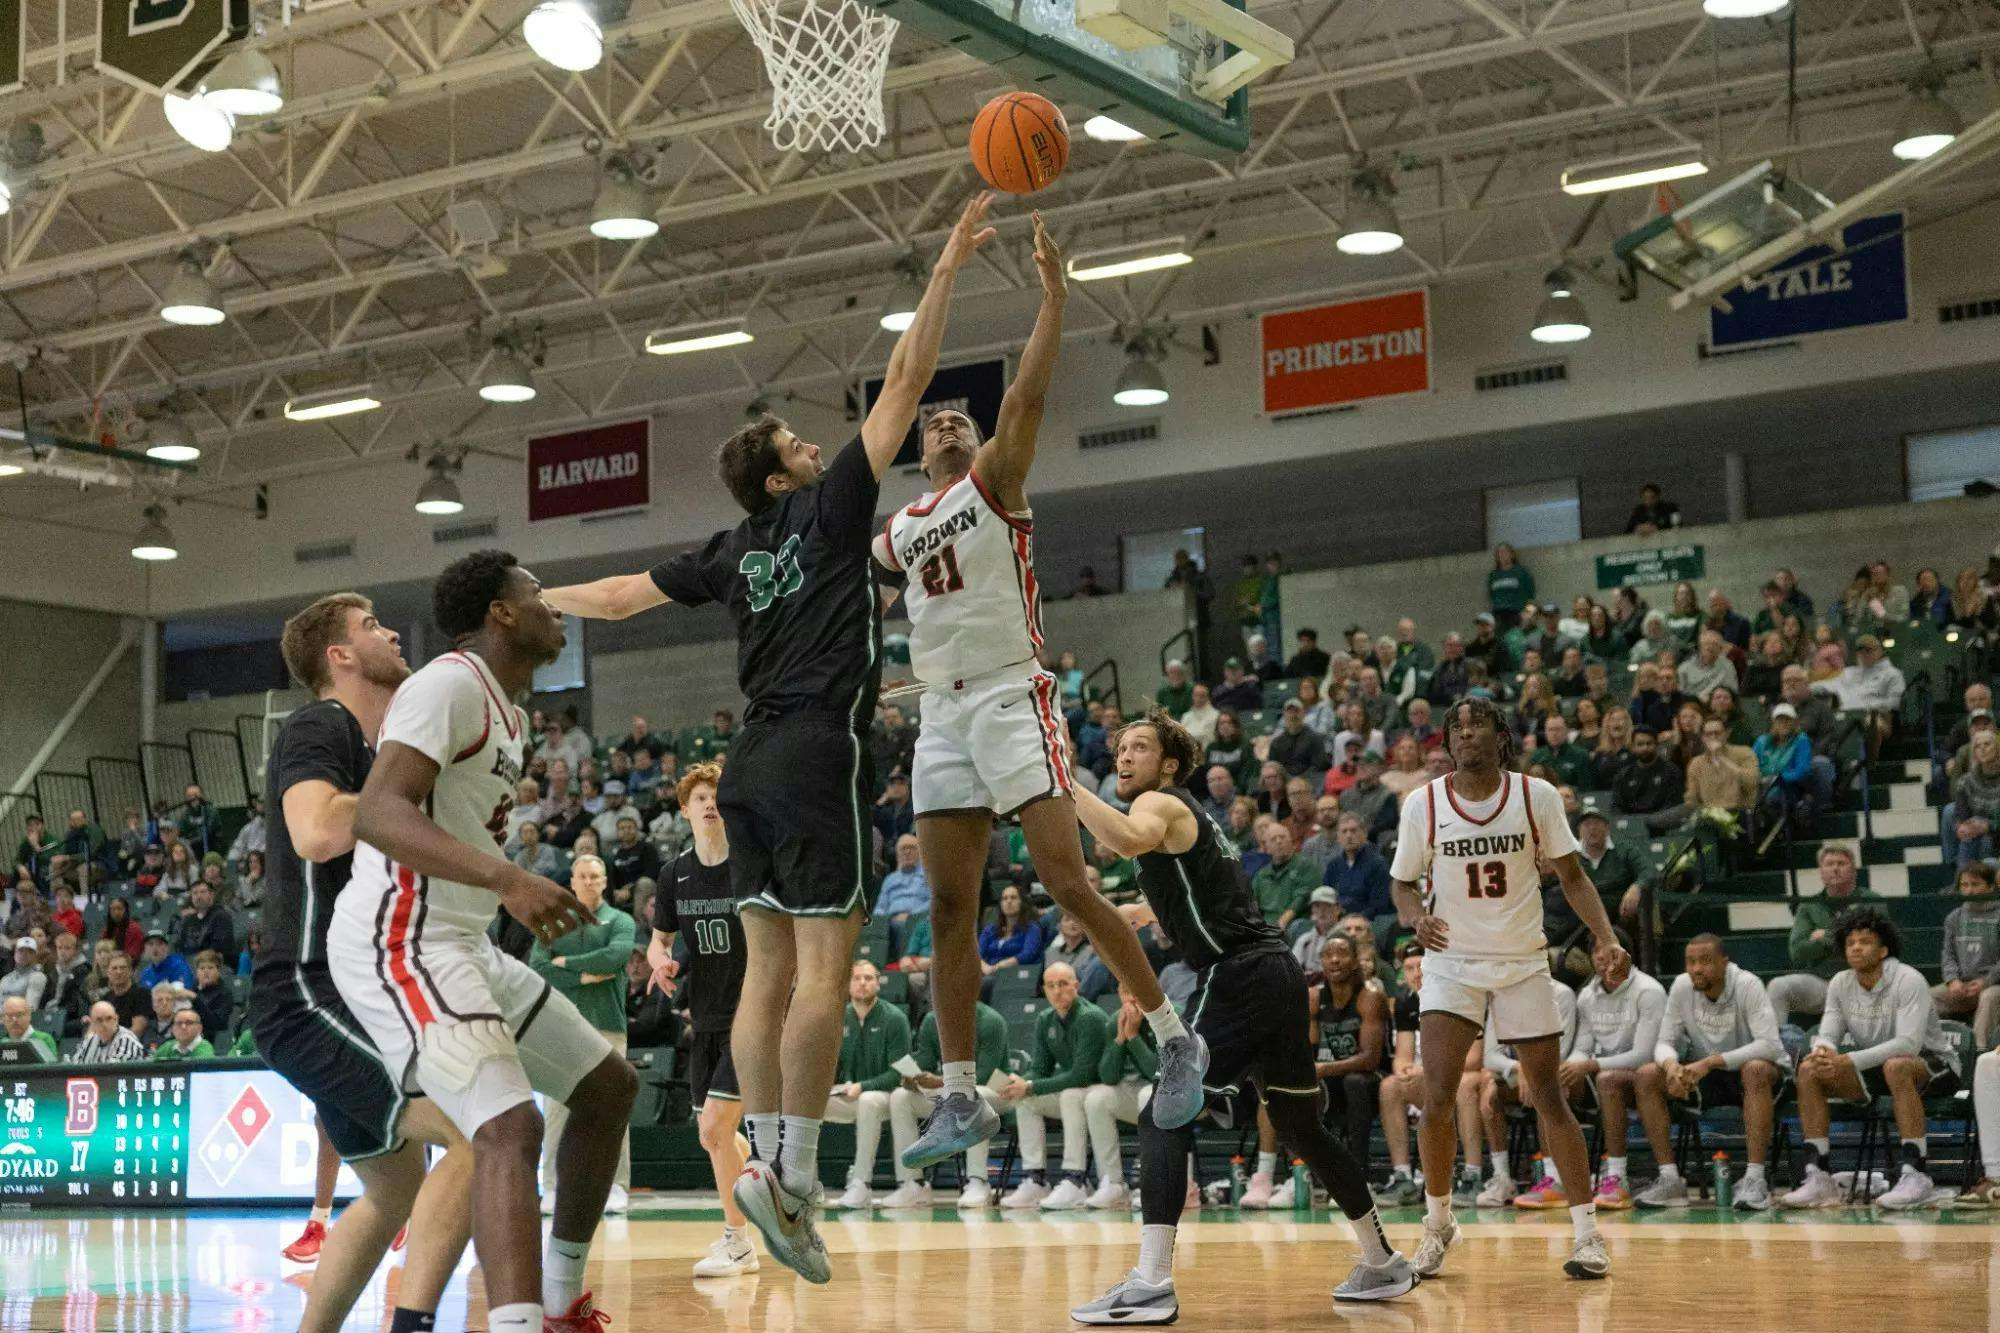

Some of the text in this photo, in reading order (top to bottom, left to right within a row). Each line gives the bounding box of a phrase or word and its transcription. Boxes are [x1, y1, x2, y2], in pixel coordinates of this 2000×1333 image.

[1762, 259, 1853, 301] YALE
[1265, 326, 1425, 378] PRINCETON
[538, 451, 640, 491] HARVARD
[903, 505, 978, 569] BROWN
[739, 534, 804, 613] 33
[919, 544, 965, 599] 21
[1441, 833, 1526, 858] BROWN
[1465, 860, 1508, 899] 13
[676, 898, 737, 916] DARTMOUT
[695, 918, 731, 954] 10
[65, 1077, 99, 1136] B
[137, 1092, 143, 1107] 1
[69, 1140, 90, 1172] 17
[134, 1158, 140, 1174] 1
[151, 1158, 158, 1174] 1
[134, 1180, 140, 1196] 1
